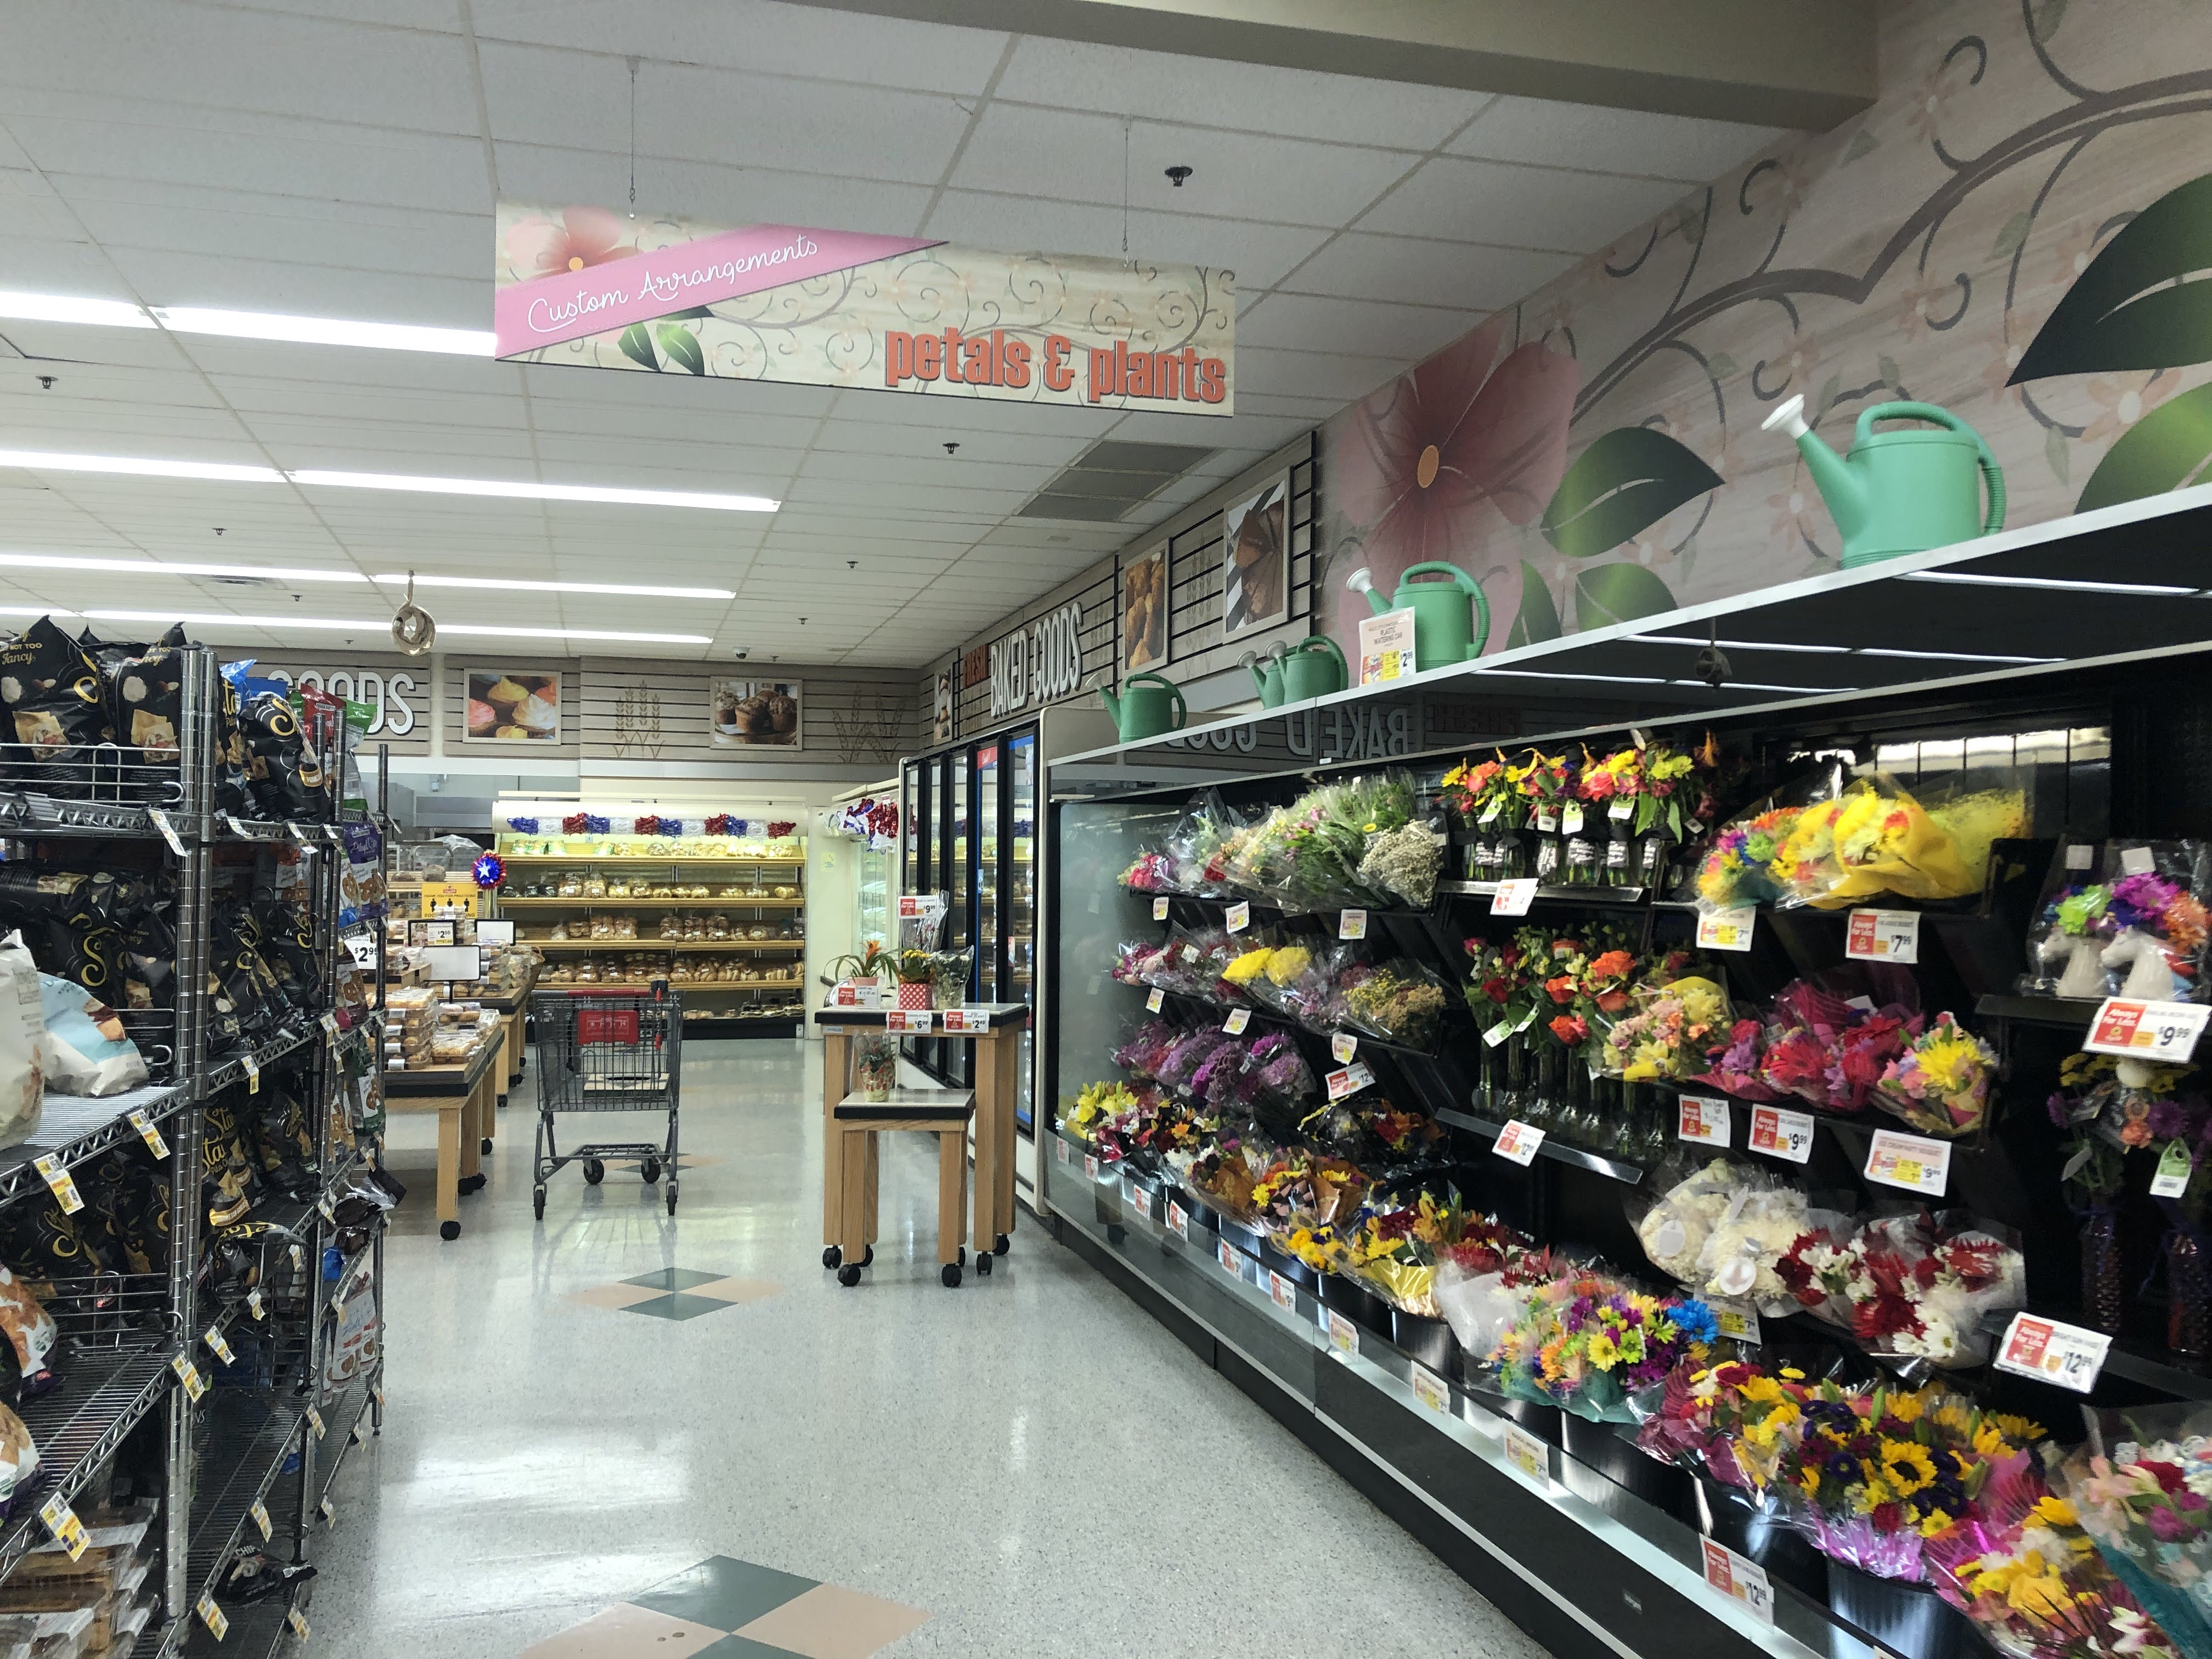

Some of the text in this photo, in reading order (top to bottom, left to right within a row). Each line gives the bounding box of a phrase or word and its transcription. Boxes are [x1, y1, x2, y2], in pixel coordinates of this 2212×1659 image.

[528, 233, 818, 333] Custom Arrangements
[885, 327, 1226, 403] petals & plants
[991, 602, 1084, 719] BAKED GOODS
